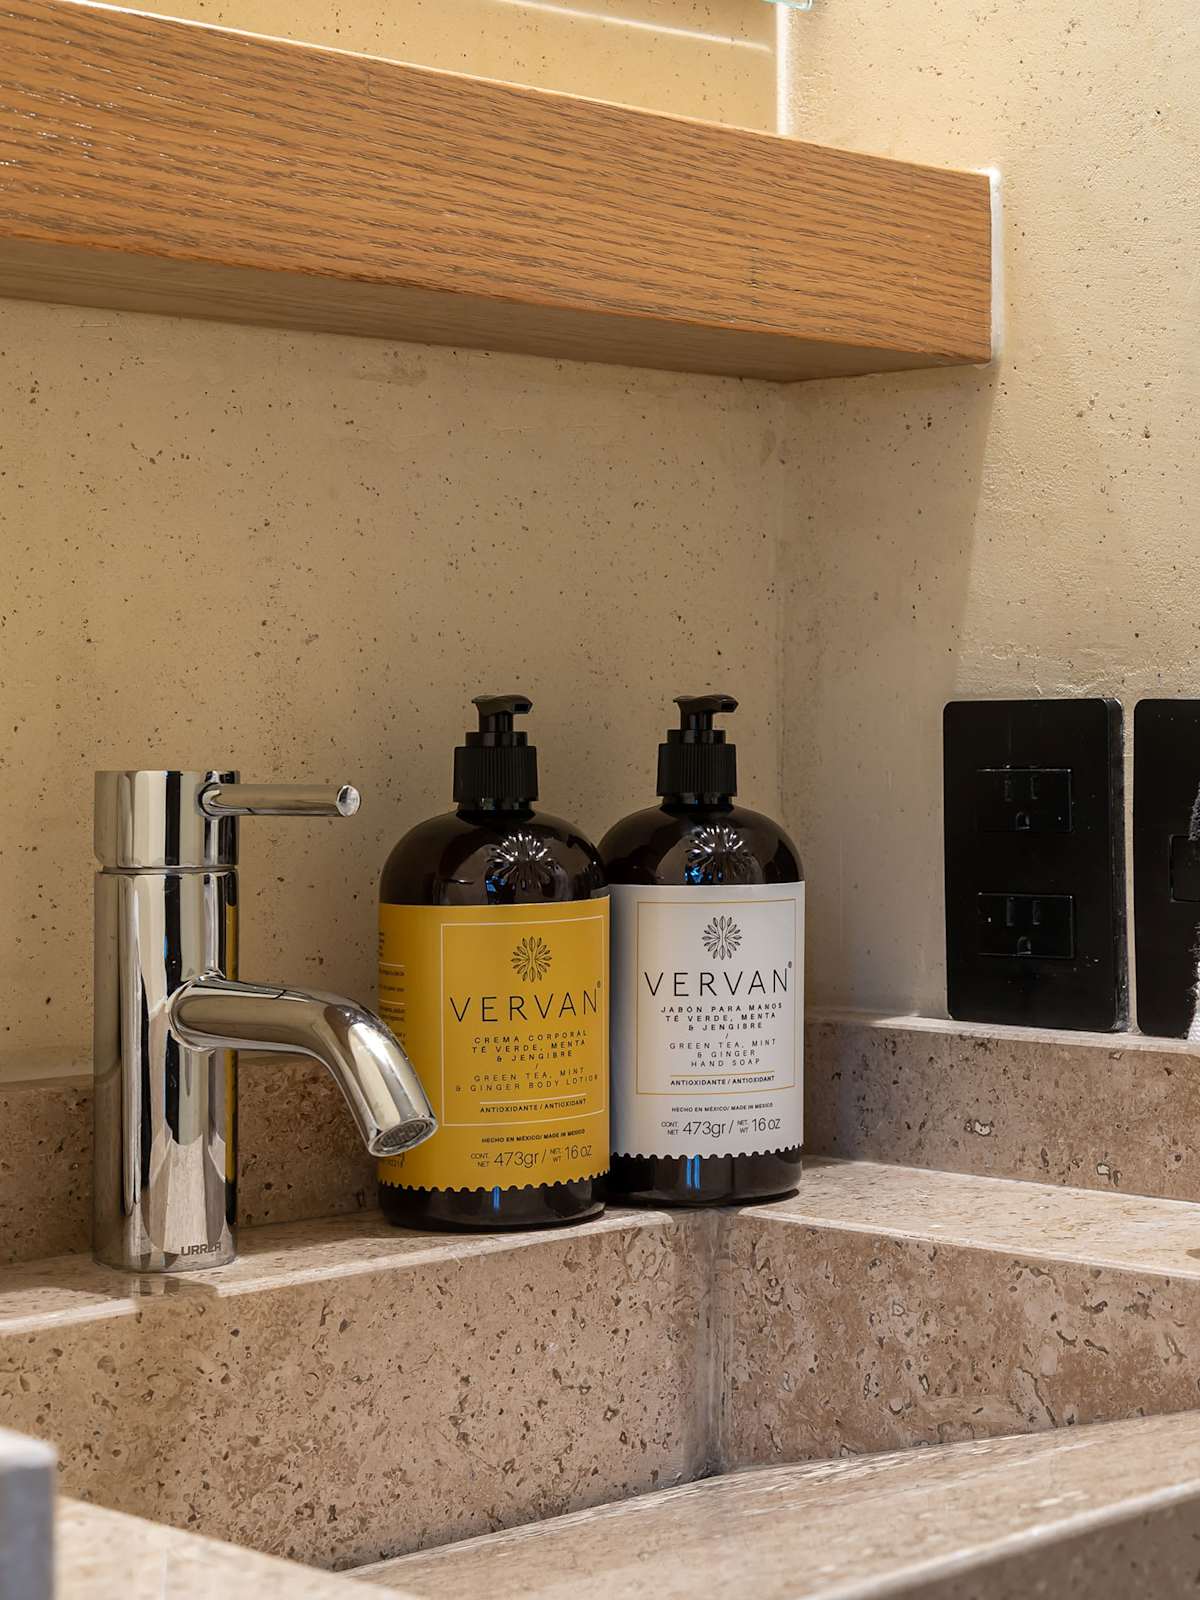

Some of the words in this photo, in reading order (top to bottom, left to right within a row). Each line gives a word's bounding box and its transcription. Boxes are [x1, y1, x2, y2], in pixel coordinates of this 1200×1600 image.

[661, 1004, 703, 1013] JABÓN
[749, 1002, 782, 1011] MANOS
[665, 1014, 679, 1022] TÉ
[688, 1015, 733, 1023] VERDE,
[741, 1012, 776, 1021] MENTA
[702, 1022, 763, 1031] JENGIBRE
[474, 1035, 520, 1044] CREMA
[528, 1029, 588, 1042] CORPORAL
[472, 1045, 486, 1053] TÉ
[496, 1044, 543, 1053] VERDE,
[551, 1039, 586, 1049] MENTA
[669, 1042, 711, 1050] GREEN
[719, 1041, 744, 1049] TEA,
[752, 1038, 776, 1047] MINT
[512, 1050, 573, 1062] JENGIBRE
[711, 1049, 756, 1058] GINGER
[691, 1060, 724, 1068] HAND
[732, 1058, 760, 1066] SOAP
[474, 1074, 517, 1082] GREEN
[526, 1071, 552, 1080] TEA,
[560, 1067, 585, 1076] MINT
[670, 1078, 726, 1086] ANTIOXIDANTE
[732, 1075, 775, 1084] ANTIOXIDANT
[470, 1083, 520, 1092] GINGER
[529, 1079, 559, 1089] BODY
[480, 1103, 538, 1113] ANTIOXIDANTE
[545, 1098, 587, 1110] ANTIOXIDANT
[682, 1120, 725, 1138] 473gr
[752, 1117, 767, 1132] 16
[768, 1118, 781, 1131] oz
[740, 1127, 749, 1135] WT
[481, 1136, 505, 1144] HECHO
[544, 1132, 559, 1140] MADE
[564, 1144, 579, 1160] 16
[494, 1150, 540, 1168] 473gr
[553, 1155, 562, 1164] WT
